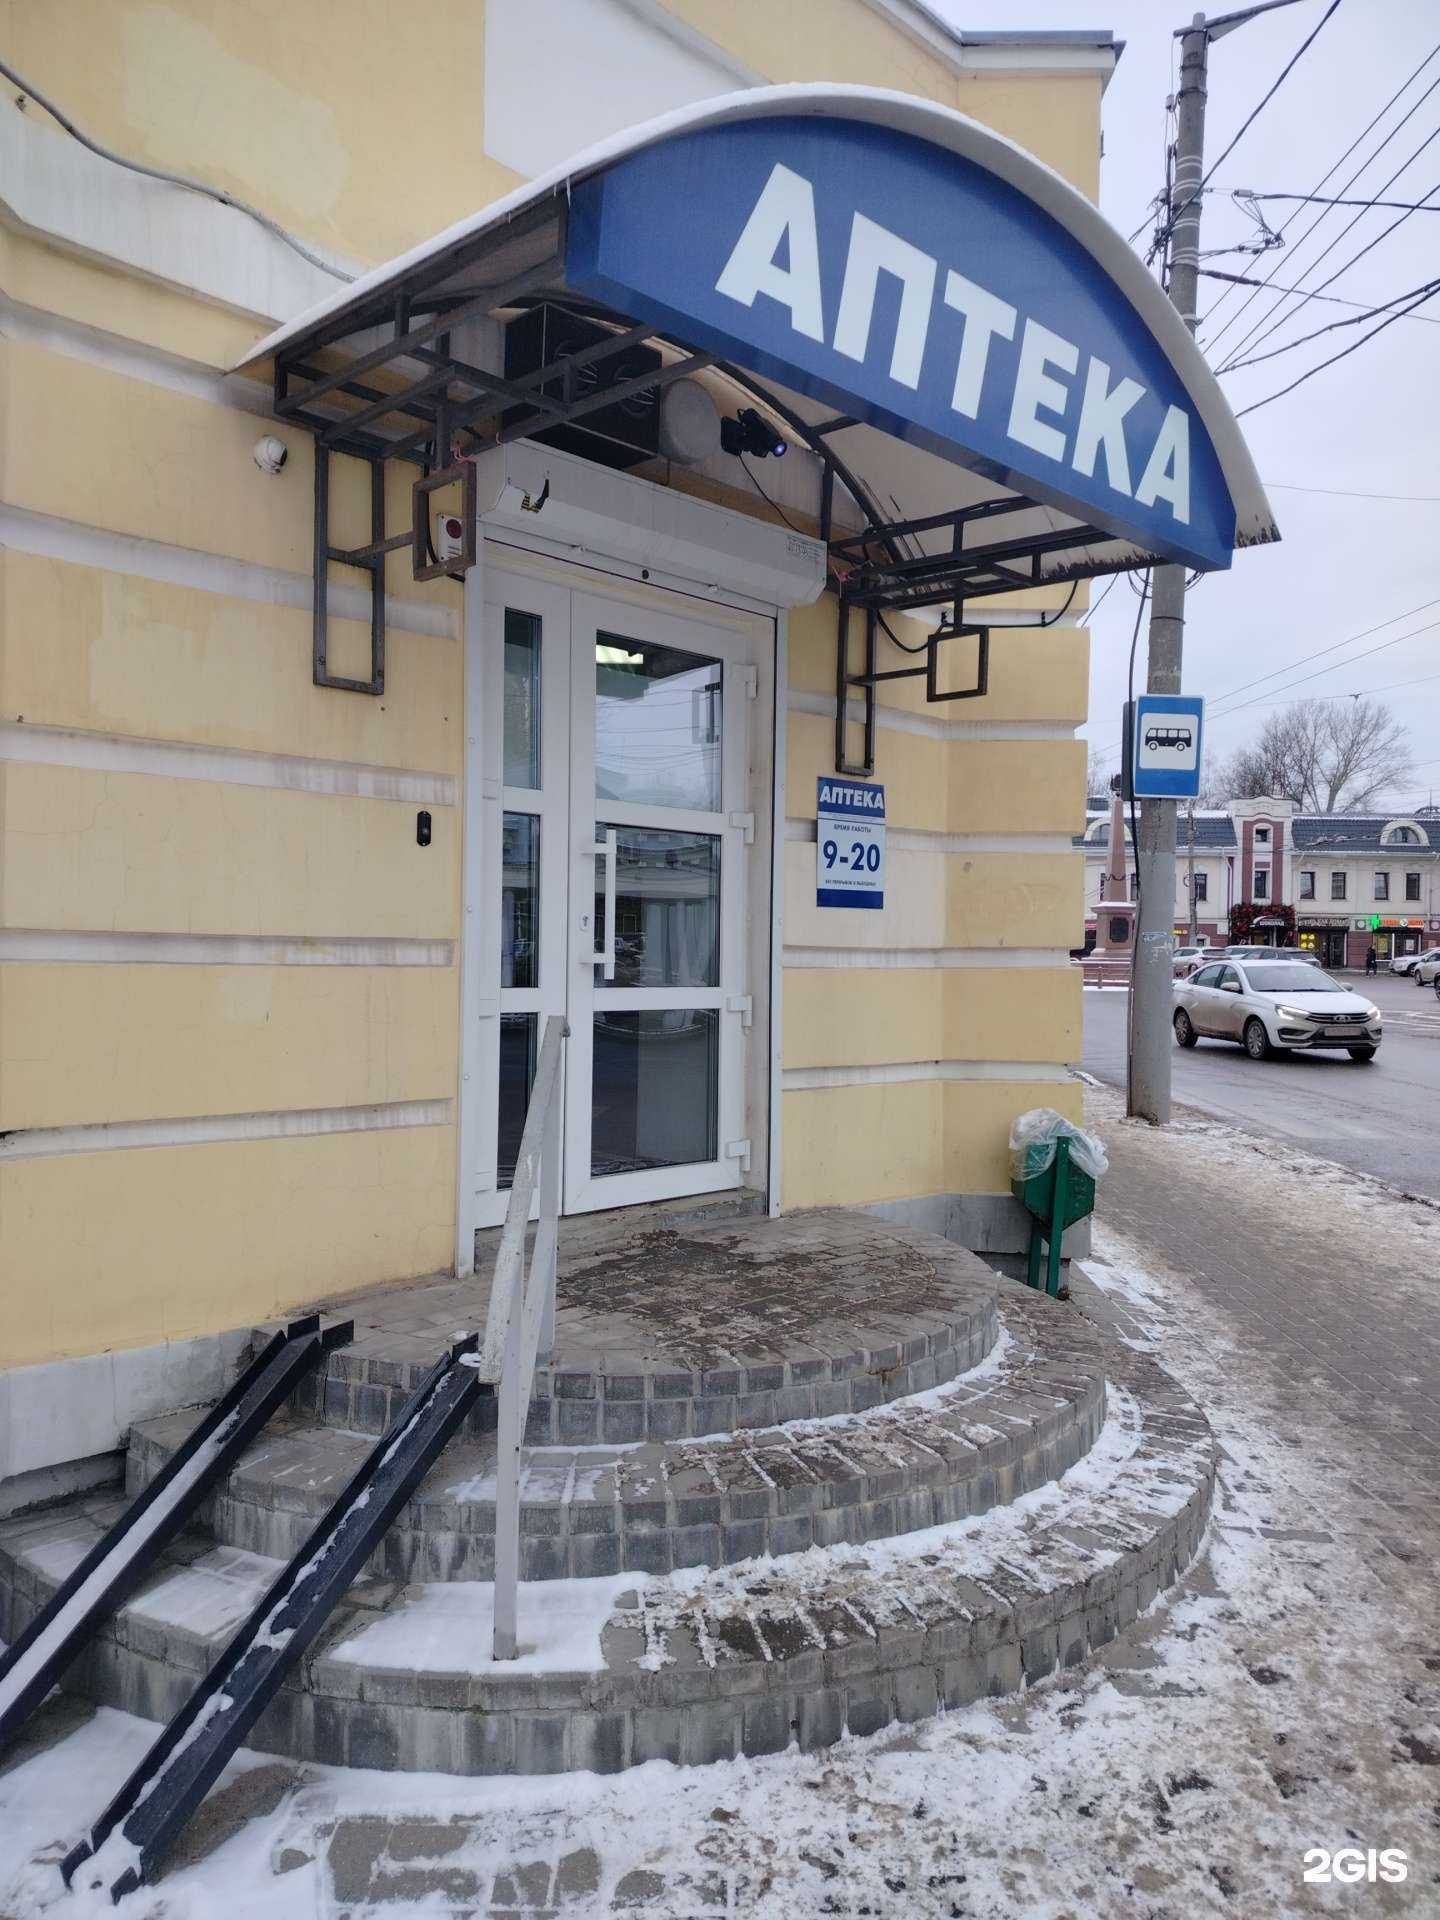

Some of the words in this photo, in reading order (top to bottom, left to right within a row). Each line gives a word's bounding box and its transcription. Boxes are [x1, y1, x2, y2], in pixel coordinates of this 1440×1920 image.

[714, 163, 1190, 525] АПТЕКА
[820, 786, 884, 809] АПТЕКА
[851, 825, 872, 833] РАБОТЫ
[823, 840, 880, 872] 9-20
